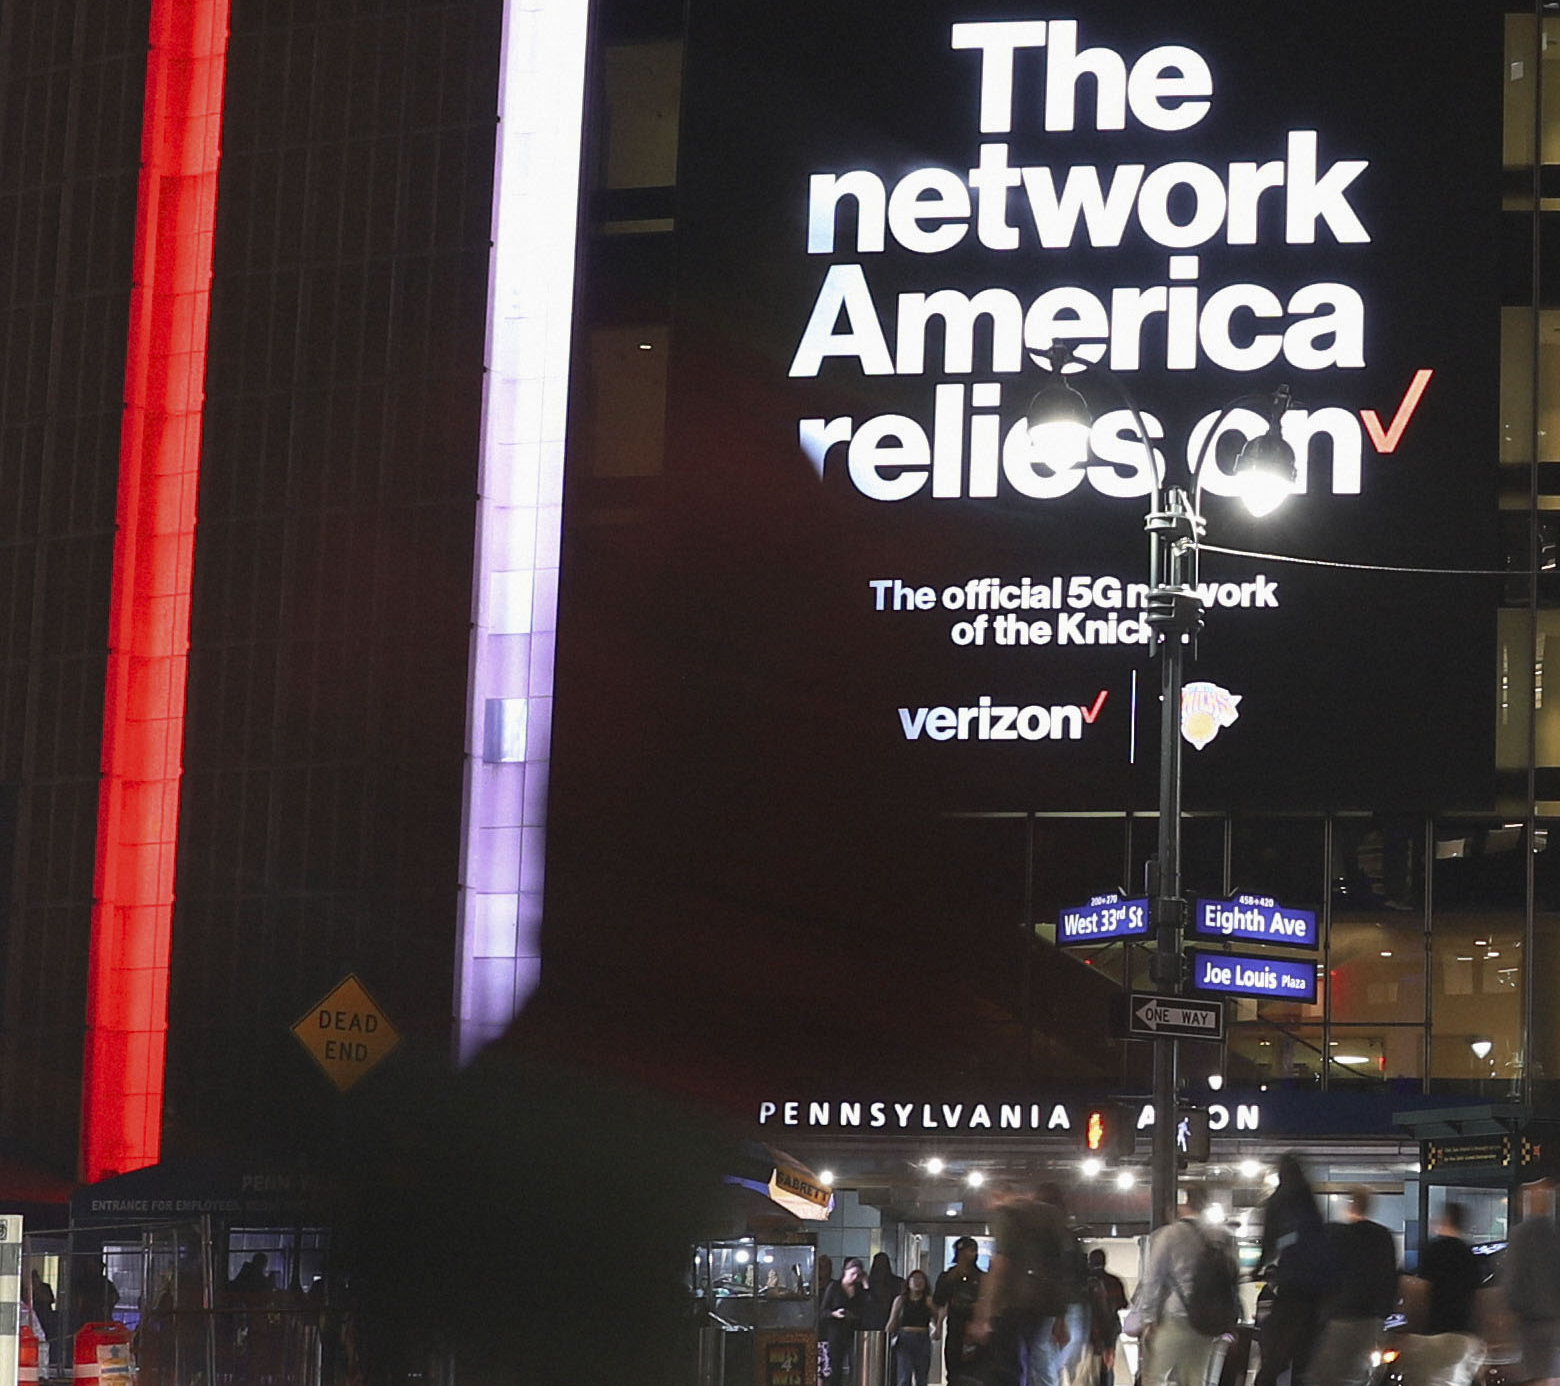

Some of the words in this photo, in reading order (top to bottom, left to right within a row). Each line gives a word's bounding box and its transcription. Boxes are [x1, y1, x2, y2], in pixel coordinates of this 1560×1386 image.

[951, 19, 1213, 133] The
[807, 130, 1371, 254] network
[788, 255, 1365, 378] America
[870, 580, 936, 611] The
[942, 577, 1061, 610] official
[1067, 576, 1122, 609] 5G
[1127, 574, 1279, 608] nwork
[951, 613, 988, 645] of
[993, 614, 1052, 645] the
[898, 696, 1083, 740] verizon
[1064, 914, 1098, 936] West
[1100, 906, 1126, 932] 33rd
[1128, 906, 1144, 928] St
[1205, 905, 1265, 935] Eighth
[1269, 912, 1306, 937] Ave
[1203, 962, 1230, 985] Joe
[1235, 965, 1277, 989] Louis
[1281, 975, 1306, 990] Plaza
[319, 1009, 378, 1033] DEAD
[1145, 1007, 1170, 1023] ONE
[1181, 1011, 1208, 1026] WAY
[325, 1040, 368, 1062] END
[759, 1102, 1070, 1130] PENNSYLVANIA
[92, 1199, 148, 1212] ENTRANCE
[151, 1200, 174, 1212] FOR
